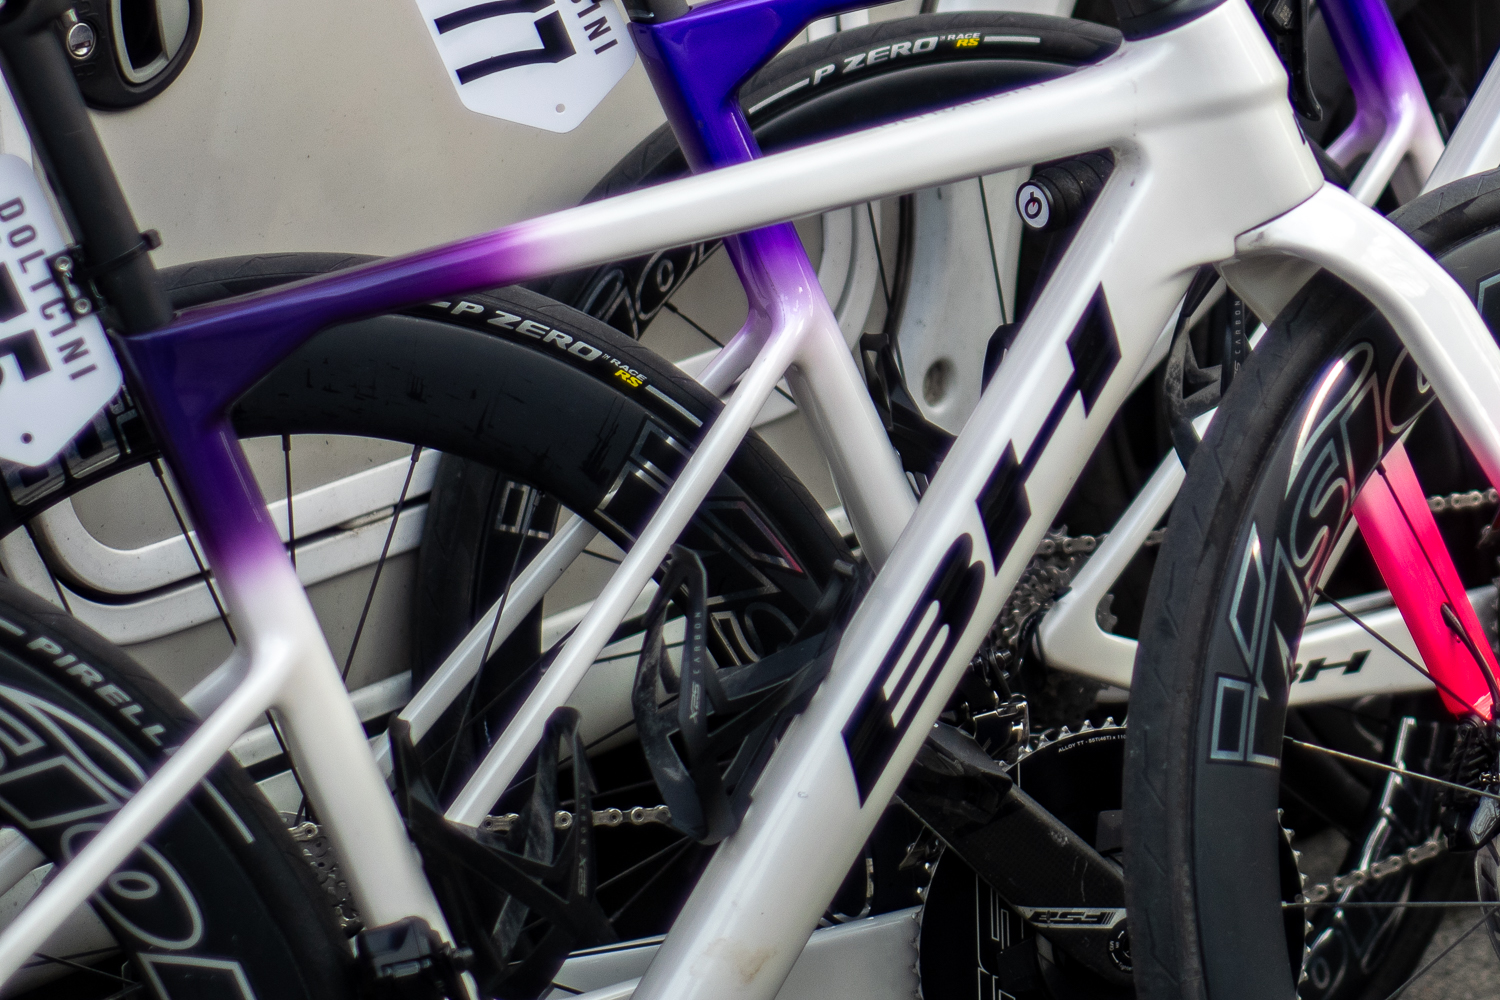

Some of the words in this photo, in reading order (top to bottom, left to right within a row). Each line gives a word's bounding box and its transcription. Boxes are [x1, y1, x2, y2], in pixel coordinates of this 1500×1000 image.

[956, 37, 980, 48] RS
[813, 64, 836, 86] P
[842, 36, 938, 74] ZERO
[451, 300, 484, 316] P
[487, 310, 602, 362] ZERO
[610, 358, 648, 382] RACE
[613, 368, 644, 389] RS
